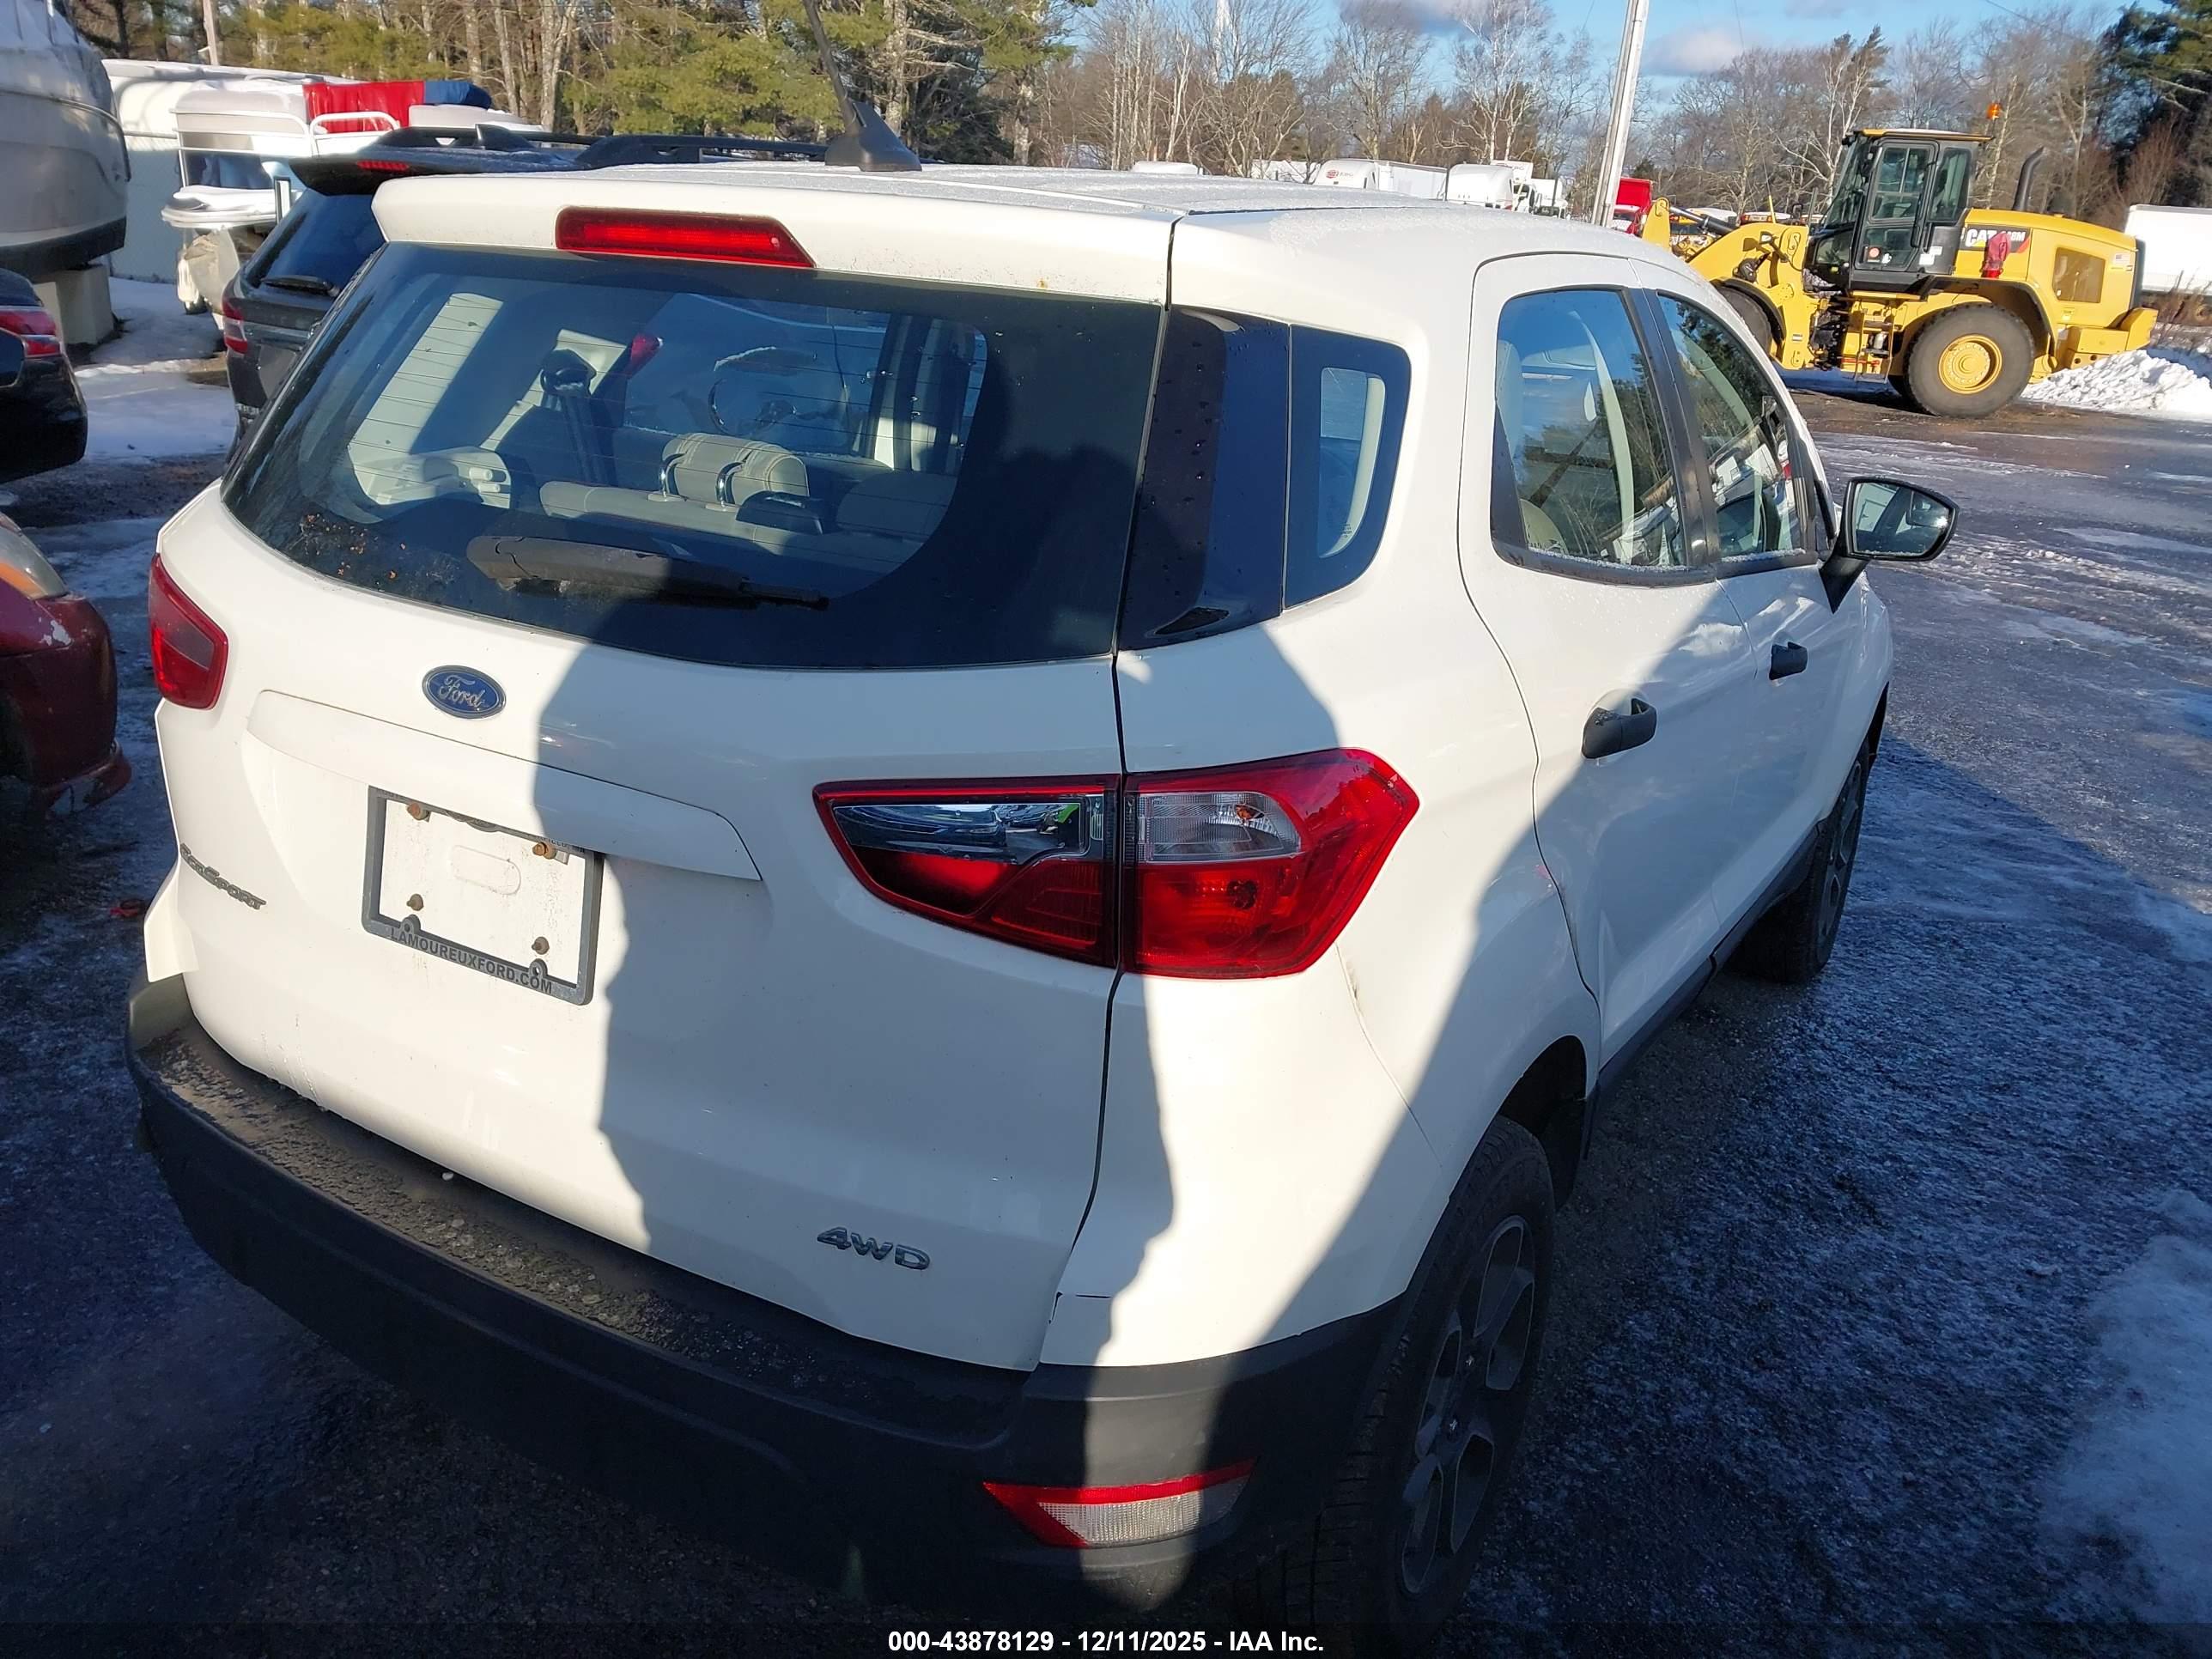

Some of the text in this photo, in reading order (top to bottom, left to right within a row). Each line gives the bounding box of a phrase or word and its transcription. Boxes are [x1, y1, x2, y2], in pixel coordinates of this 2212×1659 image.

[439, 675, 486, 708] Ford
[390, 927, 553, 994] LAMOUREUXFORD.COM
[817, 1227, 931, 1270] 4WD
